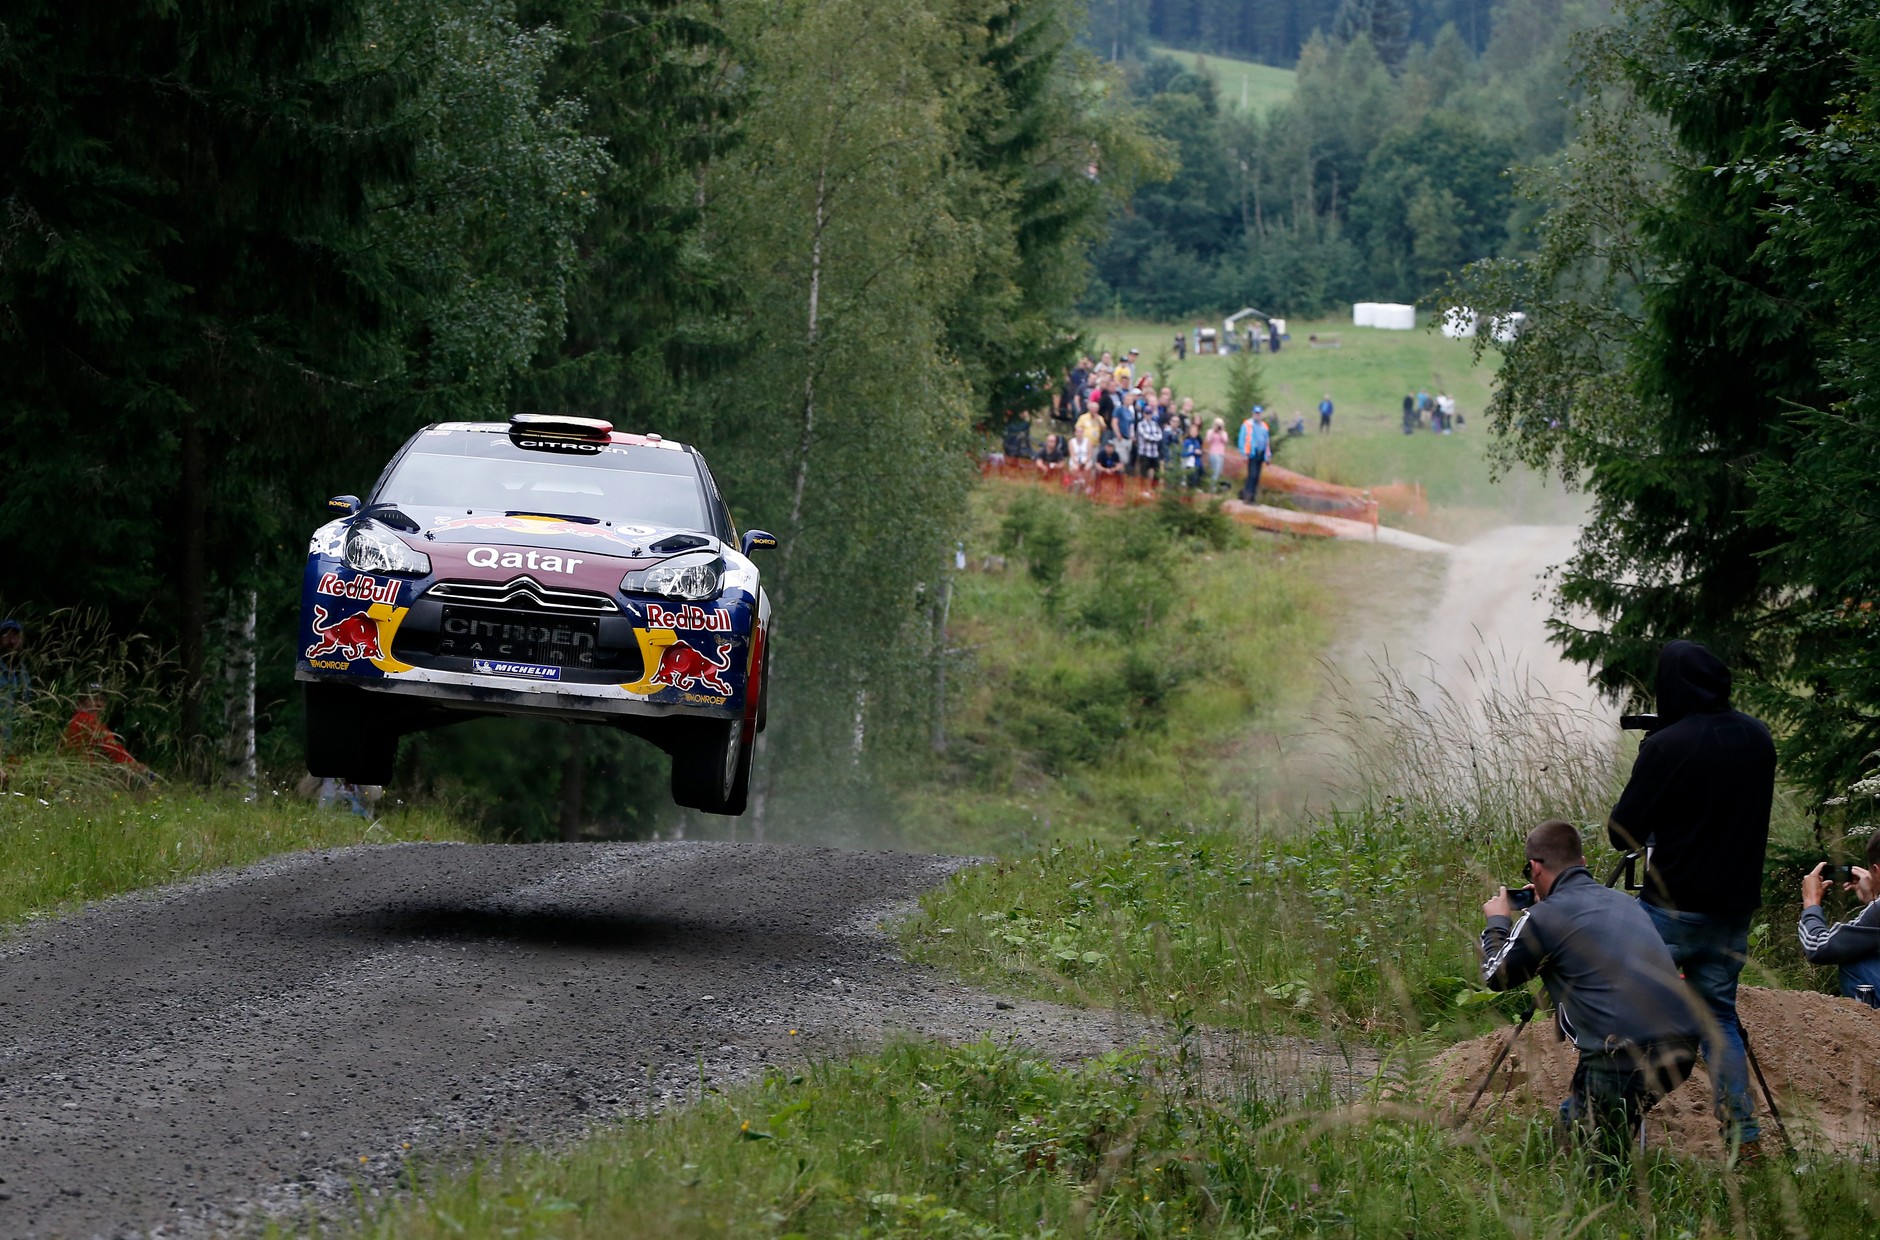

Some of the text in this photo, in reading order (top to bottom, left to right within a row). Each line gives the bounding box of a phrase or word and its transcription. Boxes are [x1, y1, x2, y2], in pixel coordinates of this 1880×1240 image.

[466, 547, 583, 575] Qatar
[310, 659, 350, 670] MONROE
[494, 664, 556, 676] MICHELIN
[685, 694, 727, 705] MONROE
